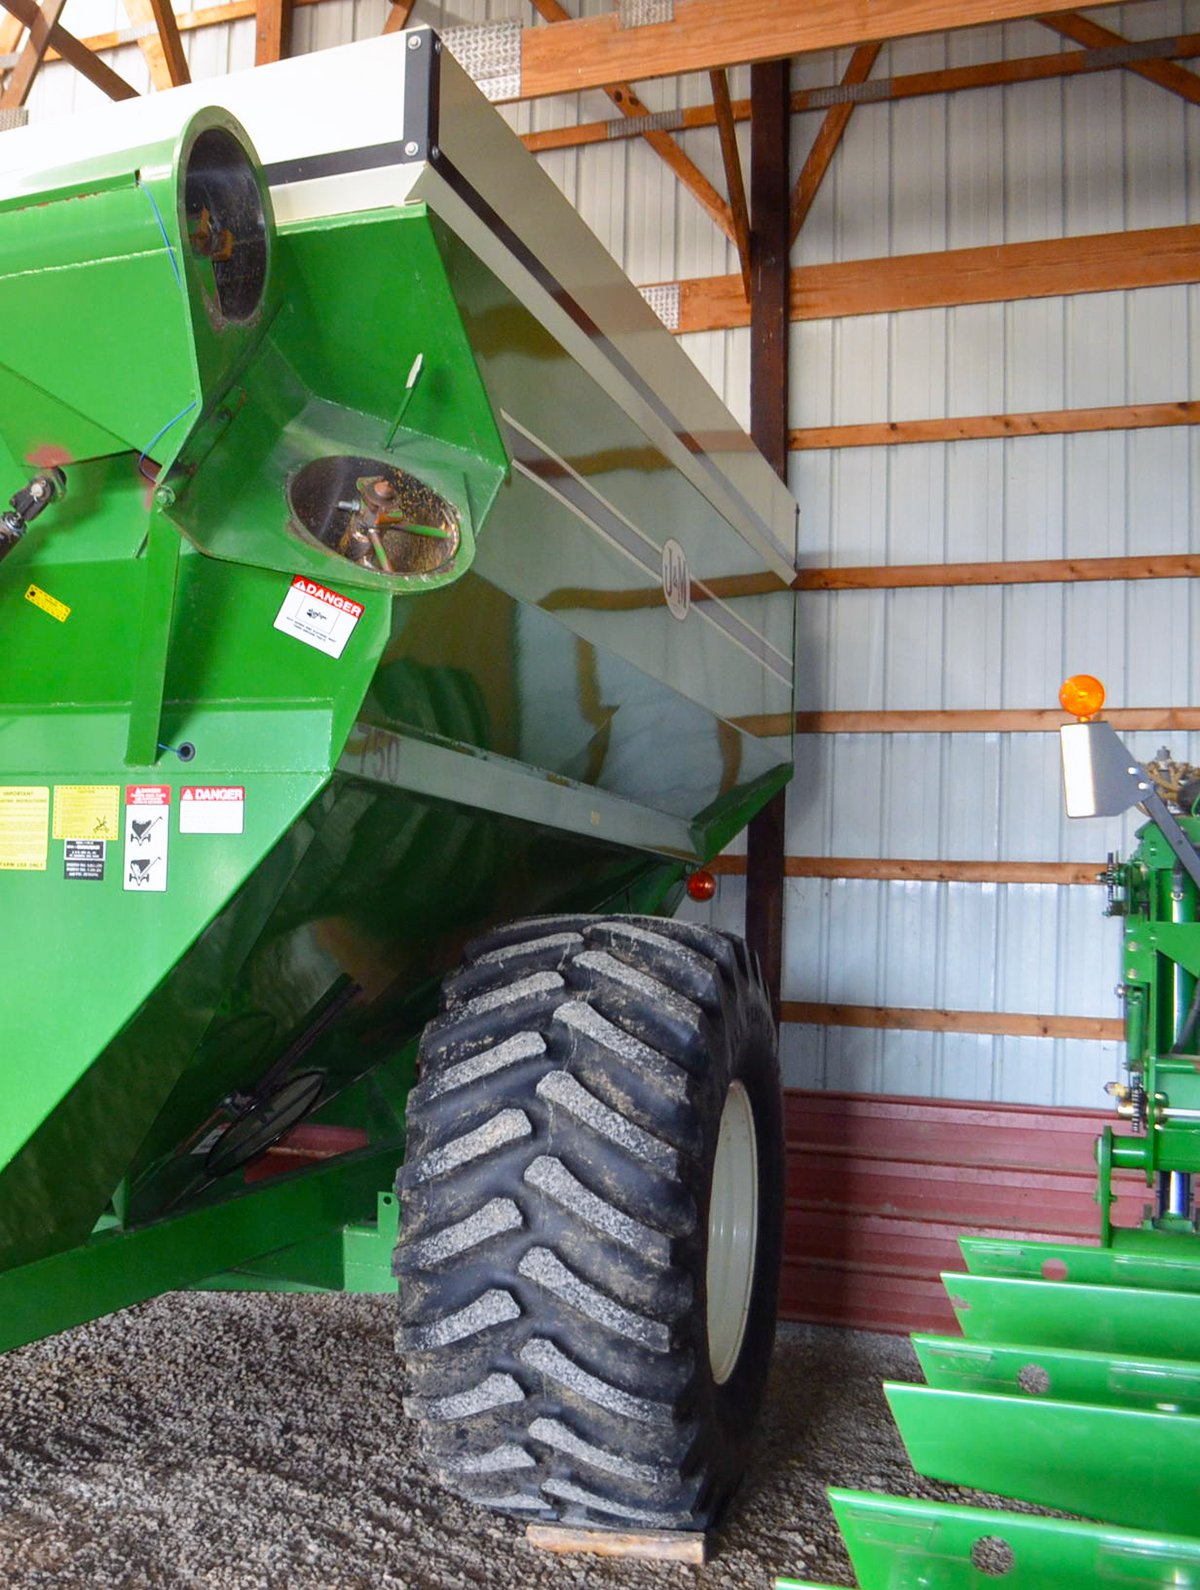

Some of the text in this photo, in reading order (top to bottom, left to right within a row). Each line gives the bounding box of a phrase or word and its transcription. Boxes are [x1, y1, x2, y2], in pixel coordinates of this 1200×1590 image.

[664, 546, 689, 609] J&M
[305, 583, 362, 617] DANGER
[194, 788, 243, 801] DANGER
